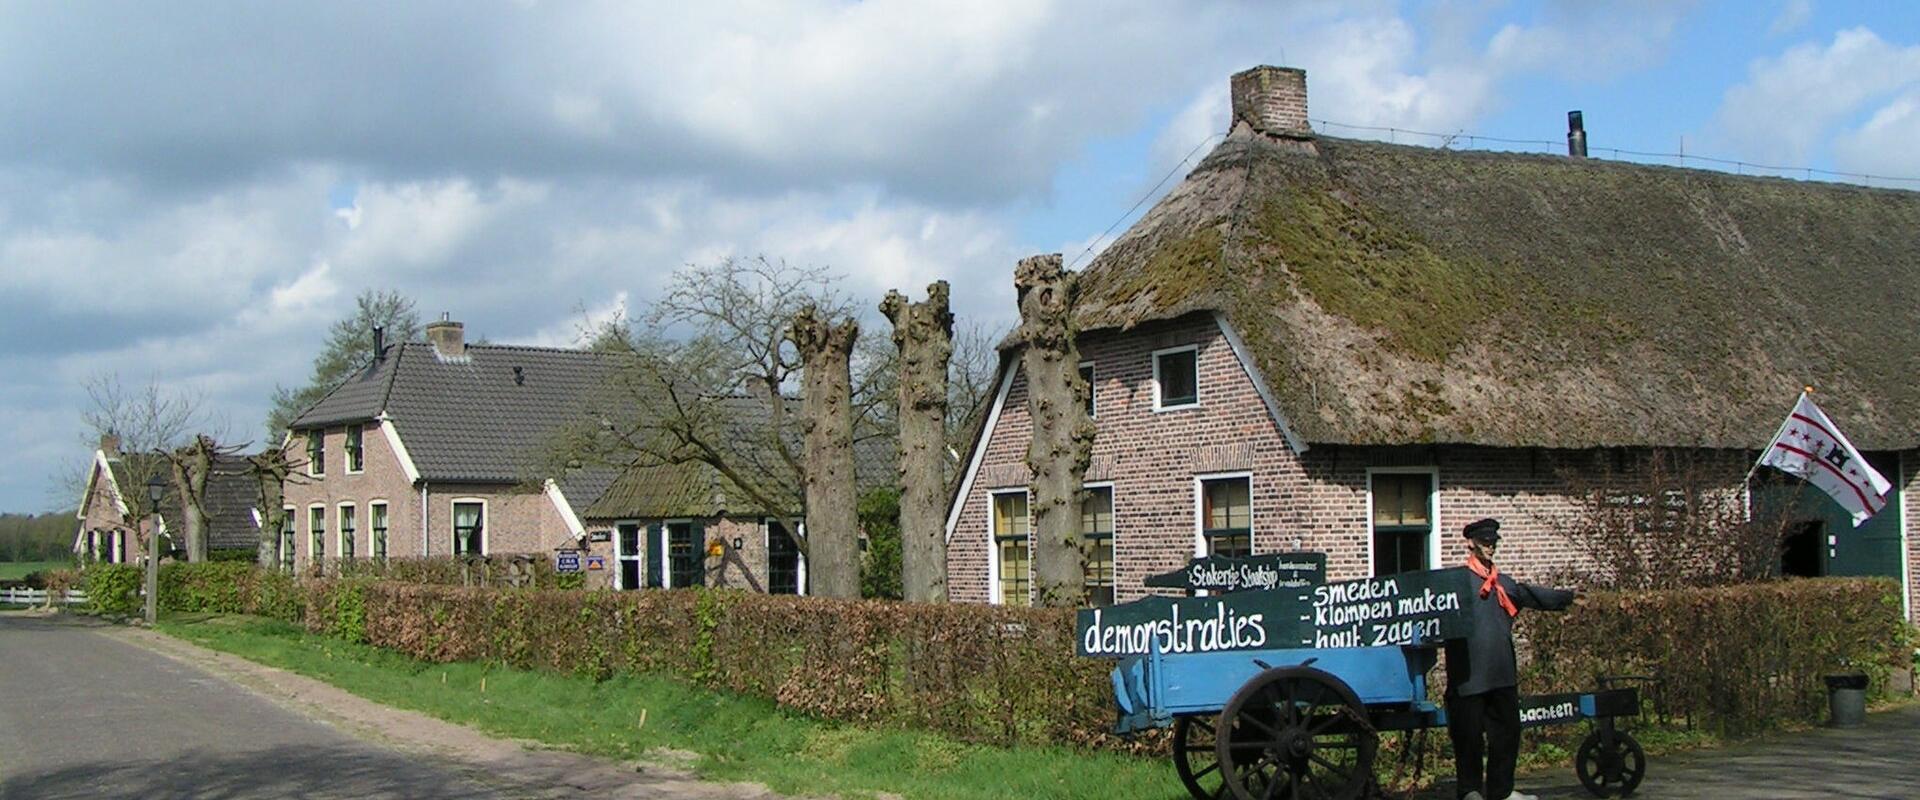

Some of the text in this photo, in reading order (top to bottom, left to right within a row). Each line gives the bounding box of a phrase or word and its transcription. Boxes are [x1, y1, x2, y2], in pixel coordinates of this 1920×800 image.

[1313, 578, 1399, 607] smeden
[1314, 602, 1393, 627] klompen
[1397, 587, 1460, 616] maken
[1084, 600, 1267, 655] demonstraties
